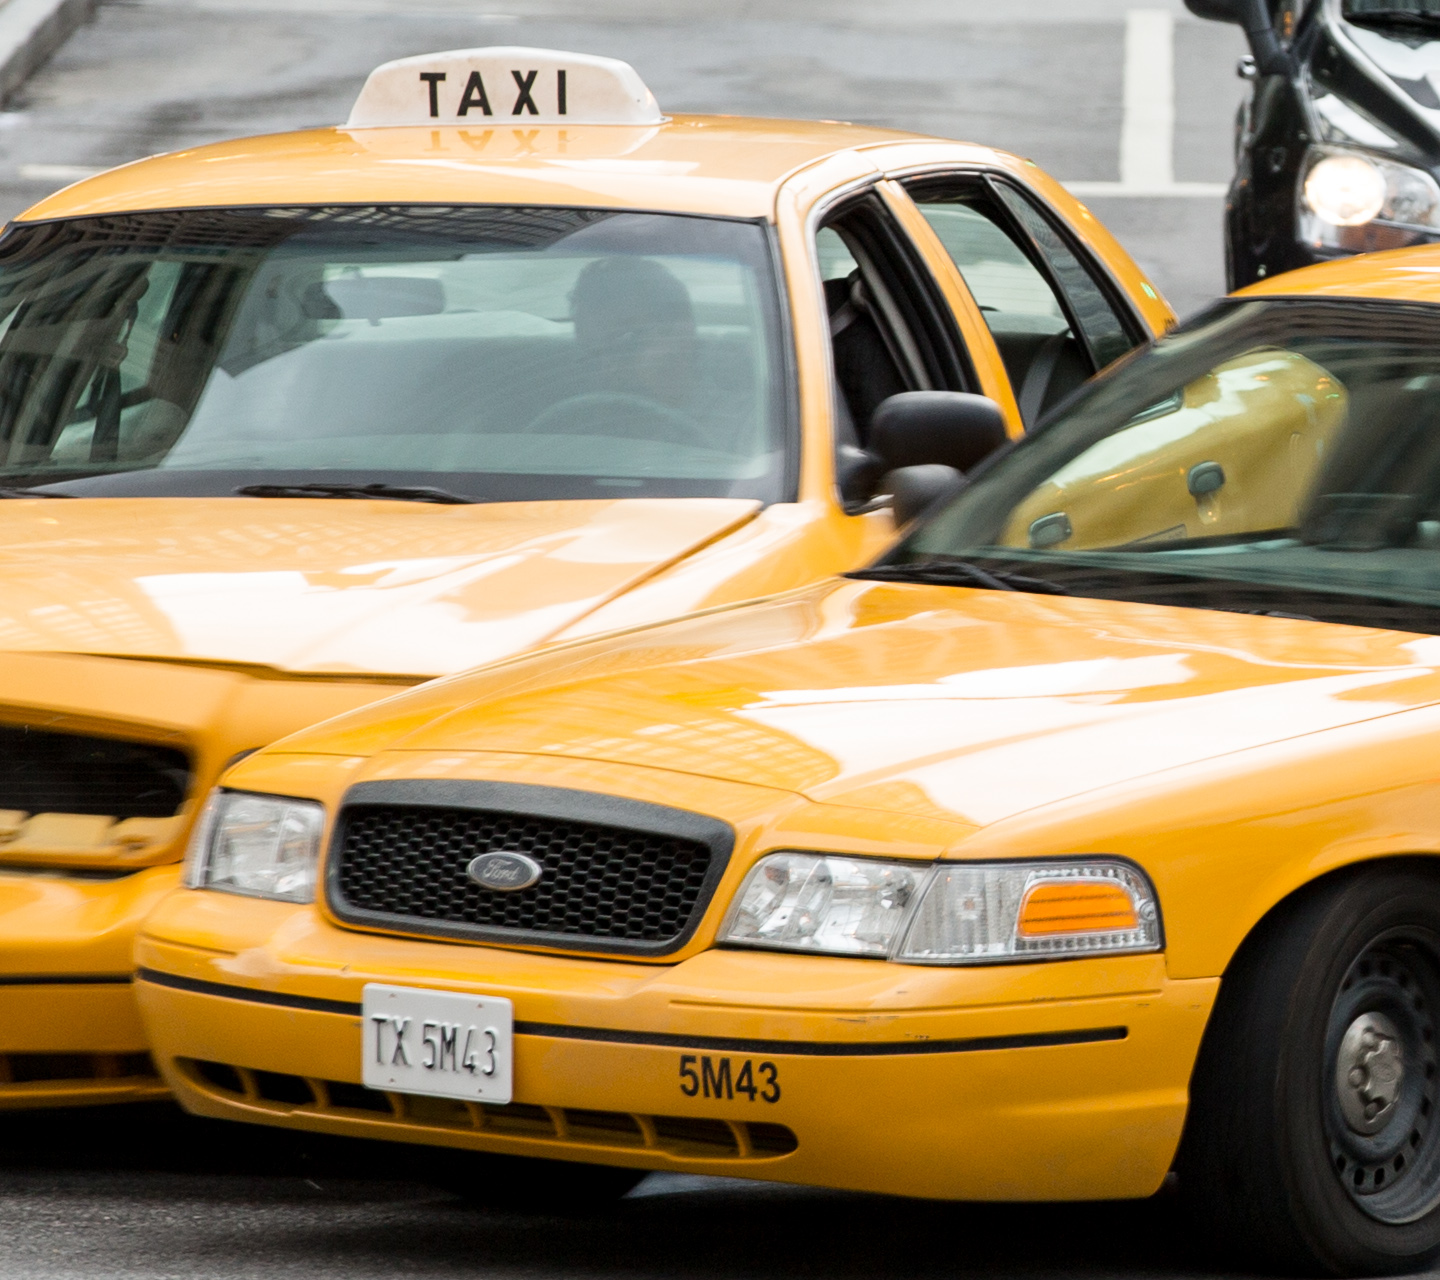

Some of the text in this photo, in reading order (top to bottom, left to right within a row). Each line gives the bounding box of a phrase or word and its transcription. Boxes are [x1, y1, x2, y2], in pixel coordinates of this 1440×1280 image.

[419, 69, 568, 118] TAXI
[483, 858, 521, 881] Ford
[371, 1013, 501, 1077] TX 5M43
[679, 1054, 782, 1104] 5M43
